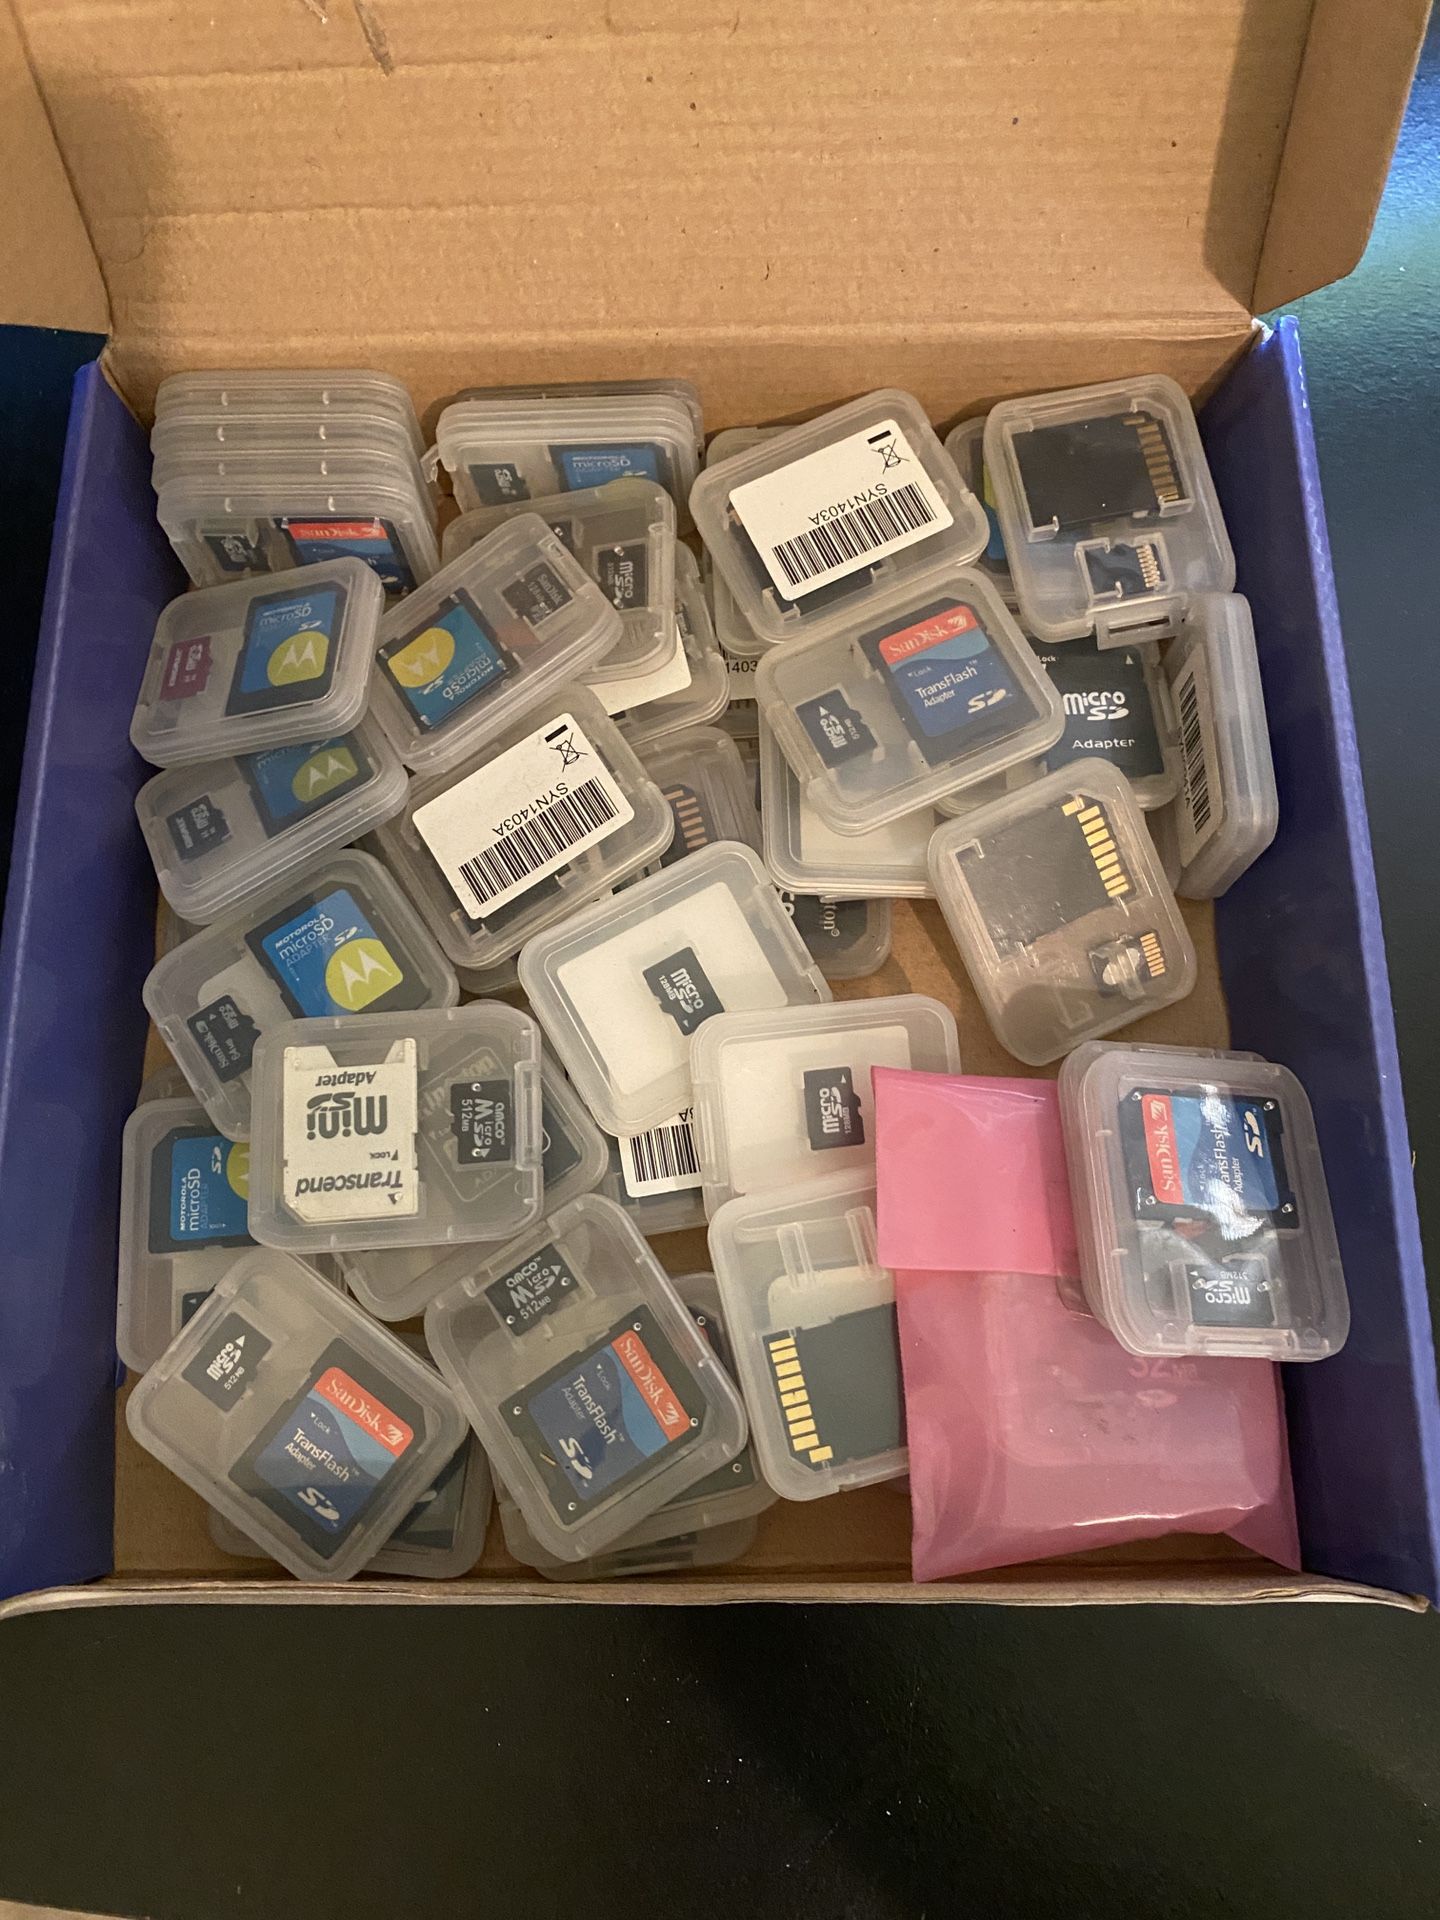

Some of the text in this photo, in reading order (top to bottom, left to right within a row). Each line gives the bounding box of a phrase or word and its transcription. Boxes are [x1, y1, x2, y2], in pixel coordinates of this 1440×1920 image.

[808, 482, 888, 526] SYN1403A
[620, 561, 634, 599] micro
[888, 625, 949, 657] SanDisk
[914, 666, 978, 699] TransFlash
[923, 689, 957, 707] Adapter
[1063, 691, 1126, 716] micro
[819, 718, 847, 749] micro
[1072, 737, 1136, 750] Adapter
[493, 782, 569, 837] SYN1403A
[274, 913, 328, 950] MOTOROLA
[279, 917, 335, 961] microSD
[658, 975, 676, 1001] 128MB
[670, 966, 704, 1010] micro
[315, 1070, 377, 1088] Adapter
[306, 1094, 388, 1141] mini
[461, 1098, 473, 1133] 512MB
[494, 1102, 505, 1139] amco
[819, 1087, 840, 1134] micro
[369, 1150, 391, 1160] LOCK
[1153, 1124, 1174, 1192] SanDisk
[295, 1170, 403, 1197] Transcend
[1231, 1157, 1244, 1193] Adapter
[179, 1177, 188, 1231] MOTOROLA
[190, 1168, 201, 1232] microSD
[506, 1262, 538, 1288] amco
[520, 1295, 551, 1320] 512MB
[1205, 1286, 1251, 1305] micro
[206, 1342, 234, 1381] micro
[224, 1367, 246, 1391] 512MB
[619, 1337, 663, 1406] SanDisk
[325, 1378, 383, 1432] SanDisk
[561, 1386, 587, 1421] Adapter
[571, 1374, 617, 1446] TransFlash
[284, 1442, 317, 1472] Adapter
[292, 1427, 351, 1483] TransFlash
